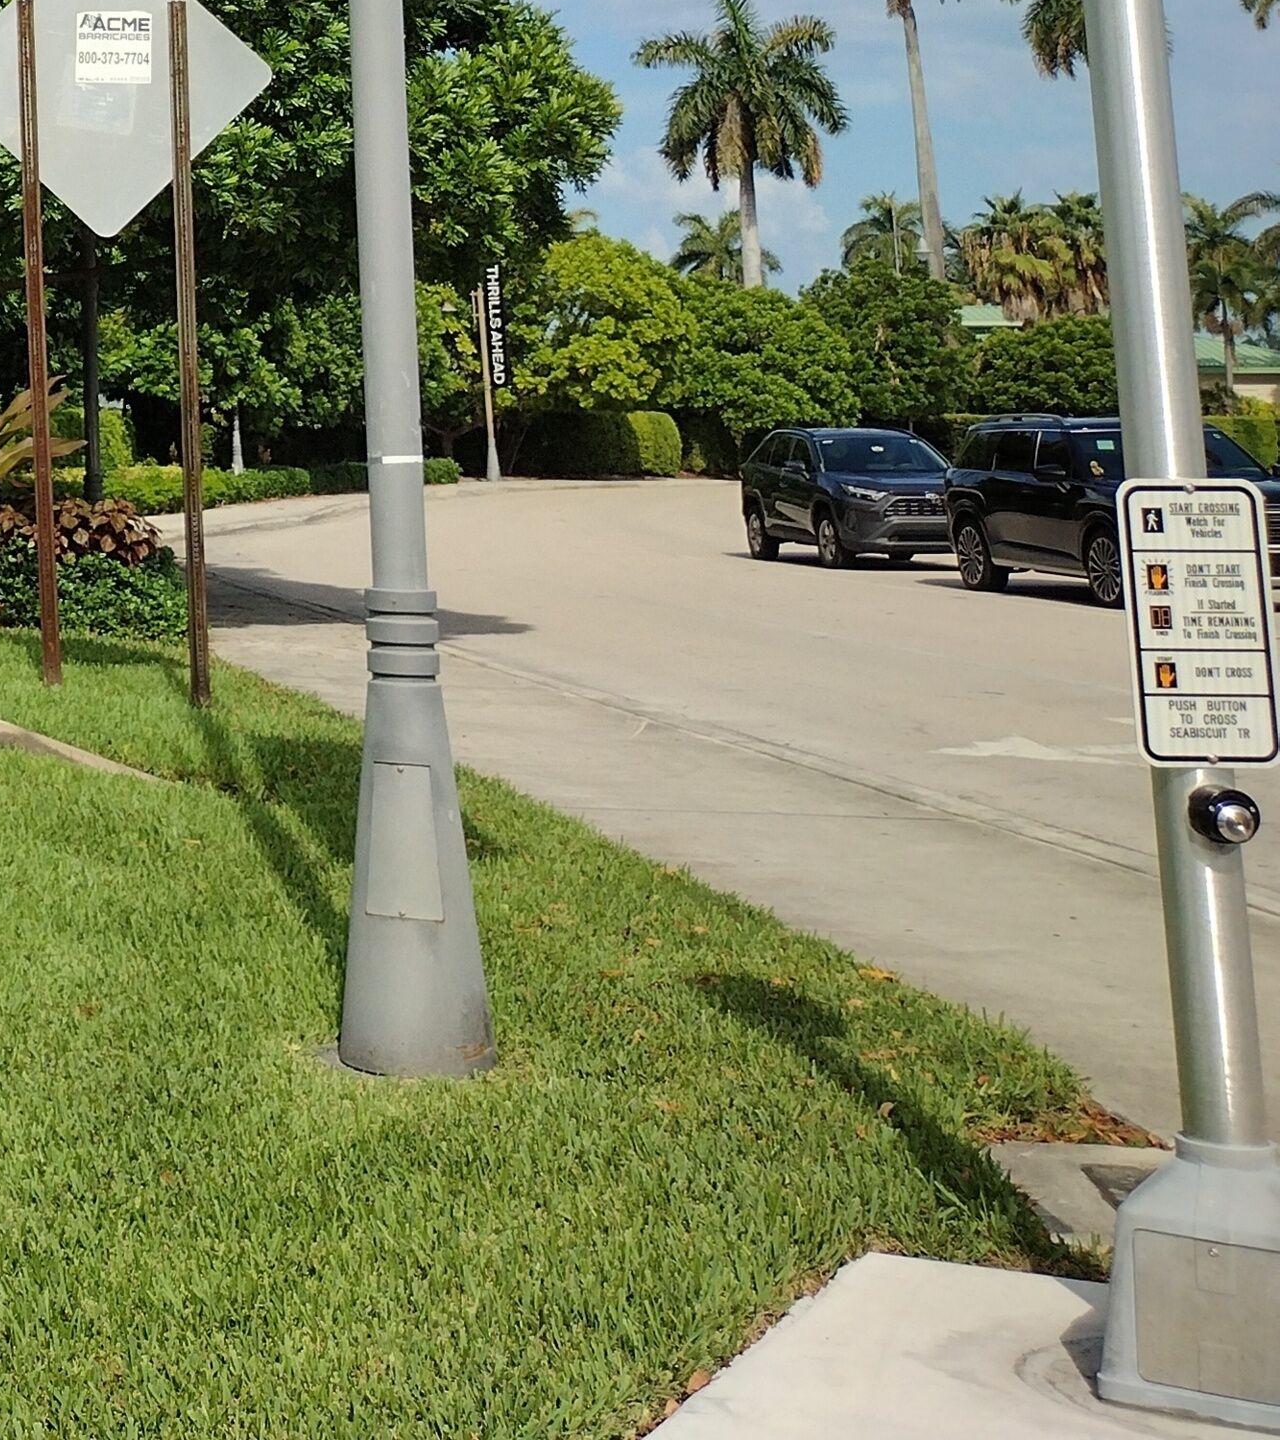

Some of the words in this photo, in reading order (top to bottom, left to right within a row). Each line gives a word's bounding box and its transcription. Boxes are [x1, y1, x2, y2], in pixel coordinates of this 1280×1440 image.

[93, 16, 150, 32] ACME
[78, 32, 151, 41] BARRICADES
[78, 51, 150, 65] 800-373-7704
[486, 264, 503, 329] THRILLS
[491, 331, 506, 385] AHEAD
[1169, 502, 1193, 514] START
[1198, 502, 1240, 514] CROSSING
[1185, 516, 1208, 527] Watch
[1213, 516, 1225, 527] For
[1191, 528, 1222, 538] Vehicles
[1186, 563, 1210, 574] DON'T
[1215, 563, 1240, 574] START
[1184, 577, 1207, 588] Finish
[1212, 577, 1245, 591] Crossing
[1208, 599, 1236, 610] Started
[1183, 616, 1202, 627] TIME
[1207, 616, 1255, 627] REMAINING
[1183, 629, 1192, 639] To
[1197, 629, 1220, 639] Finish
[1224, 629, 1257, 642] Crossing
[1195, 666, 1220, 678] DON'T
[1225, 667, 1253, 678] CROSS
[1168, 700, 1197, 711] PUSH
[1206, 700, 1247, 712] BUTTON
[1180, 713, 1193, 725] TO
[1203, 714, 1238, 725] CROSS
[1170, 727, 1227, 739] SEABISCUIT
[1237, 727, 1251, 739] TR
